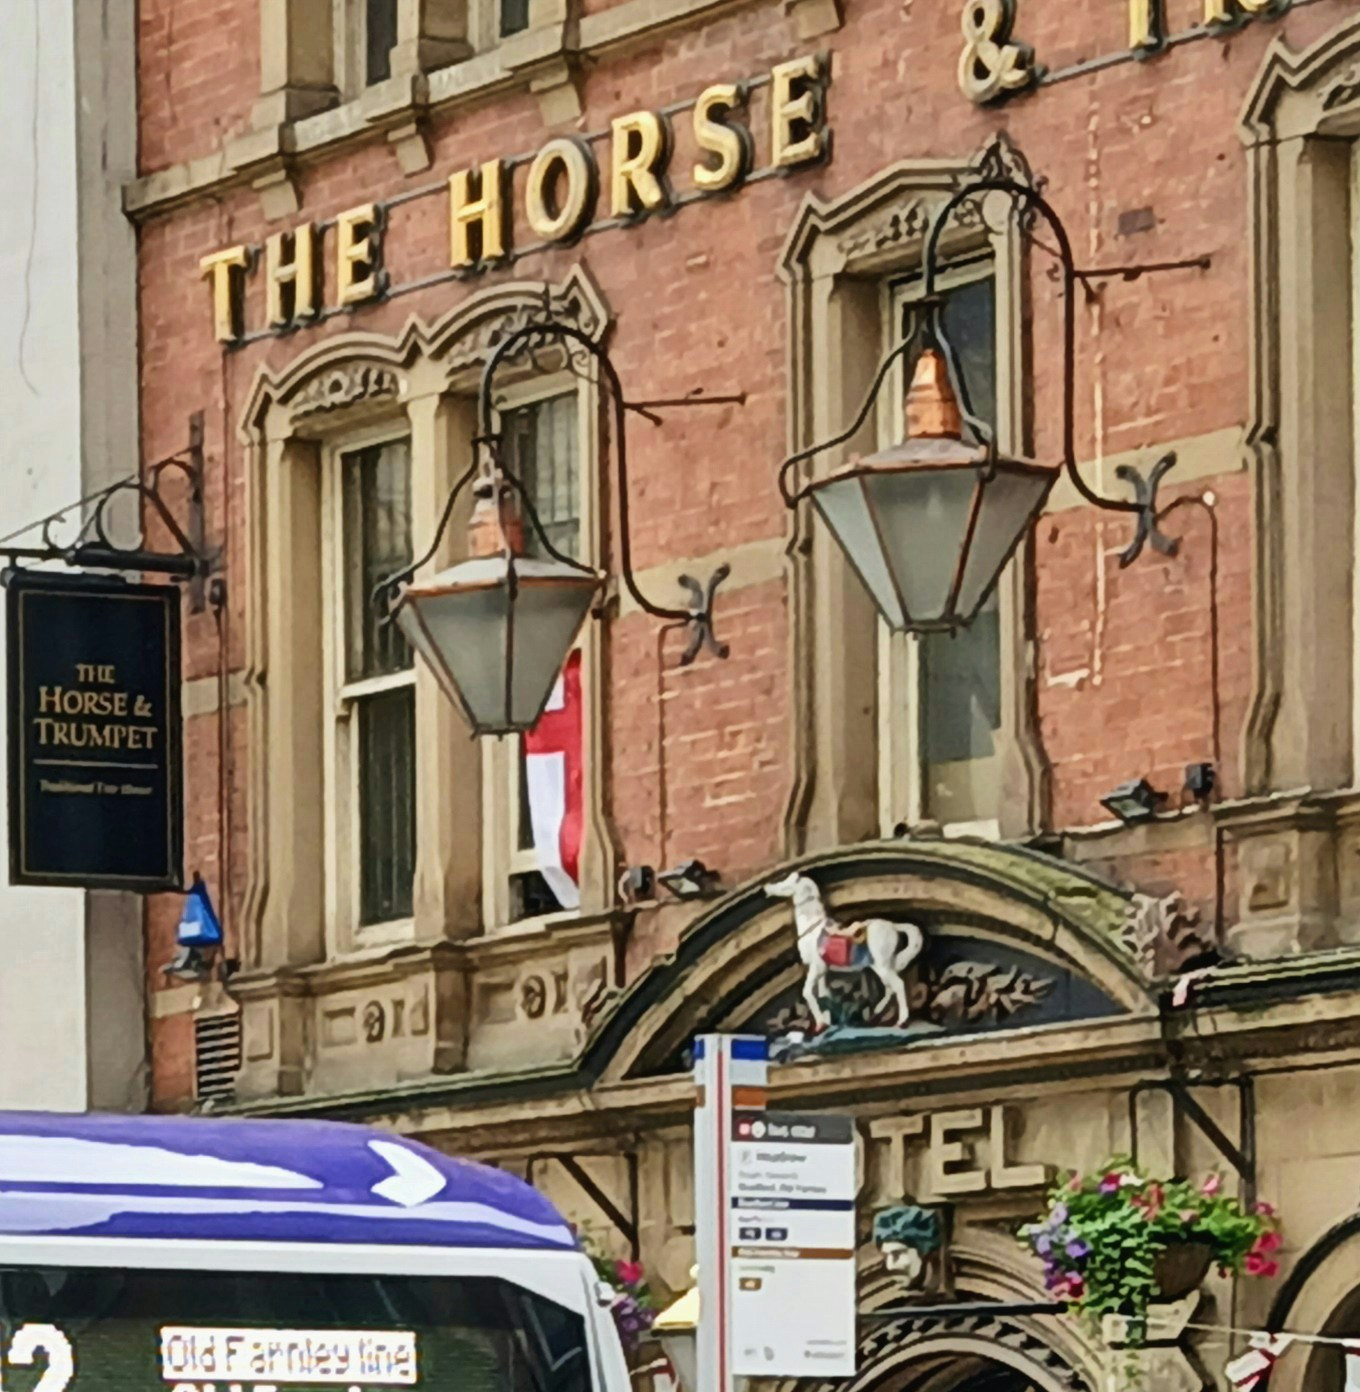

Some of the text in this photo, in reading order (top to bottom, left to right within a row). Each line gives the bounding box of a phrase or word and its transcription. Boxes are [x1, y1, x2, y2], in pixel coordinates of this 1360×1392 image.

[200, 0, 1030, 343] THE HORSE &
[75, 662, 116, 685] THE
[38, 685, 153, 718] HORSE &
[33, 717, 159, 749] TRUMPET
[854, 1105, 1045, 1199] TEL
[166, 1334, 217, 1373] Old
[225, 1334, 350, 1375] Farnley
